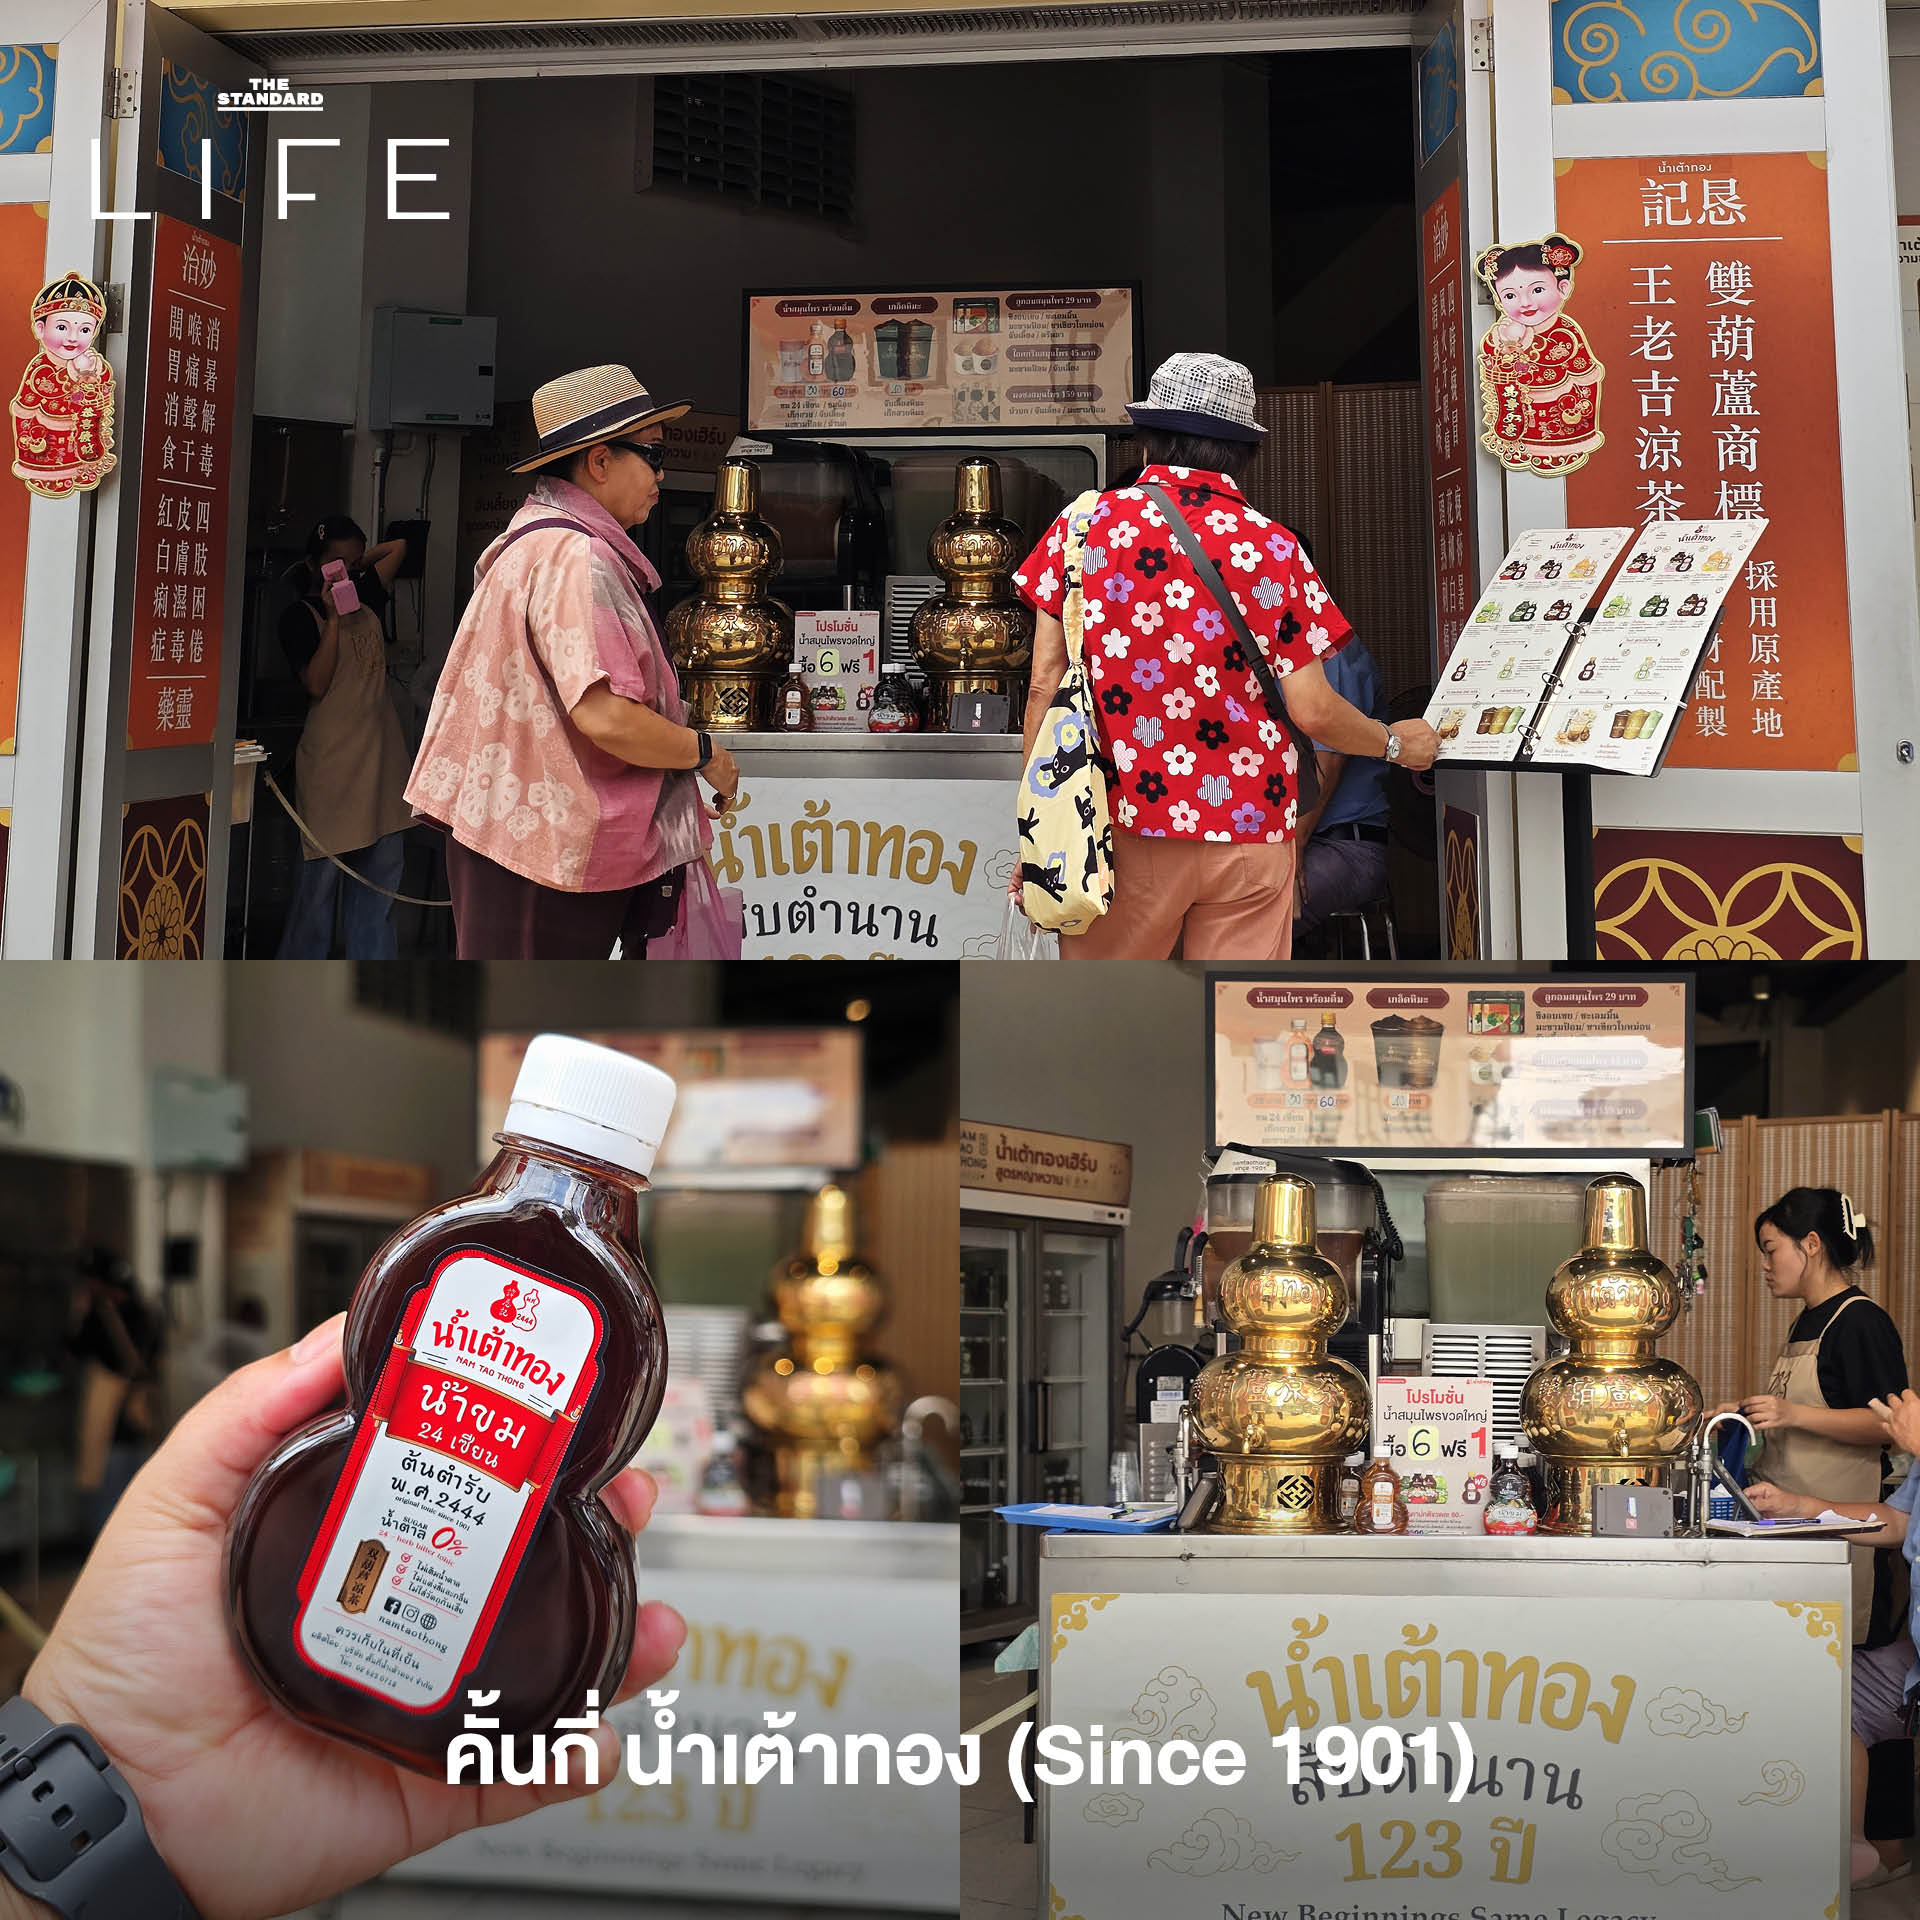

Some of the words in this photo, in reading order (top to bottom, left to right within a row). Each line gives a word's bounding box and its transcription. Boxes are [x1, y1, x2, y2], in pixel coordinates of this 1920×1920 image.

[1658, 160, 1713, 173] น้ำเต้าทอง
[161, 304, 184, 471] 開胃消食
[832, 386, 844, 397] 60
[1628, 264, 1686, 527] 王老吉涼茶
[1705, 259, 1765, 522] 雙葫蘆商標
[189, 500, 211, 664] 四肢困倦
[816, 617, 858, 632] โปรโมชั่น
[820, 651, 834, 672] 6
[841, 659, 860, 673] ฟรี
[863, 649, 875, 673] 1
[1744, 560, 1784, 738] 採用原產地
[711, 791, 978, 896] น้ำเต้าทอง
[742, 885, 938, 948] บตำนาน
[1256, 992, 1303, 1006] น้ำสมุนไพร
[1604, 993, 1617, 1002] 29
[1618, 993, 1637, 1002] บาท
[1319, 1096, 1336, 1108] 60
[516, 1313, 534, 1326] 2444
[433, 1309, 566, 1396] น้ำเต้าทอง
[456, 1355, 476, 1369] NAM
[479, 1364, 495, 1377] TAO
[497, 1371, 526, 1390] THONG
[1406, 1385, 1464, 1404] โปรโมชั่น
[420, 1380, 526, 1449] น้ำขม
[1383, 1406, 1487, 1423] น้ำสมุนไพรขวดใหญ่
[418, 1422, 444, 1443] 24
[450, 1433, 499, 1468] เซียน
[1412, 1429, 1430, 1456] 6
[1441, 1440, 1467, 1457] ฟรี
[1471, 1427, 1486, 1458] 1
[401, 1449, 491, 1504] ต้นตำรับ
[391, 1476, 487, 1527] พ.ศ.2444
[395, 1496, 420, 1508] original
[421, 1503, 437, 1515] tonic
[438, 1510, 455, 1523] since
[456, 1519, 471, 1532] 1901
[378, 1529, 388, 1537] 24
[397, 1535, 414, 1547] herb
[381, 1508, 427, 1540] น้ำตาล
[431, 1527, 469, 1556] 0%
[403, 1515, 428, 1531] SUGAR
[335, 1625, 420, 1670] ควรเก็บในที่เย็น
[379, 1615, 448, 1653] namtaothong
[1244, 1613, 1637, 1746] น้ำเต้าทอง
[1335, 1819, 1463, 1883] 123
[1488, 1816, 1537, 1885] ปี
[1222, 1903, 1288, 1920] New
